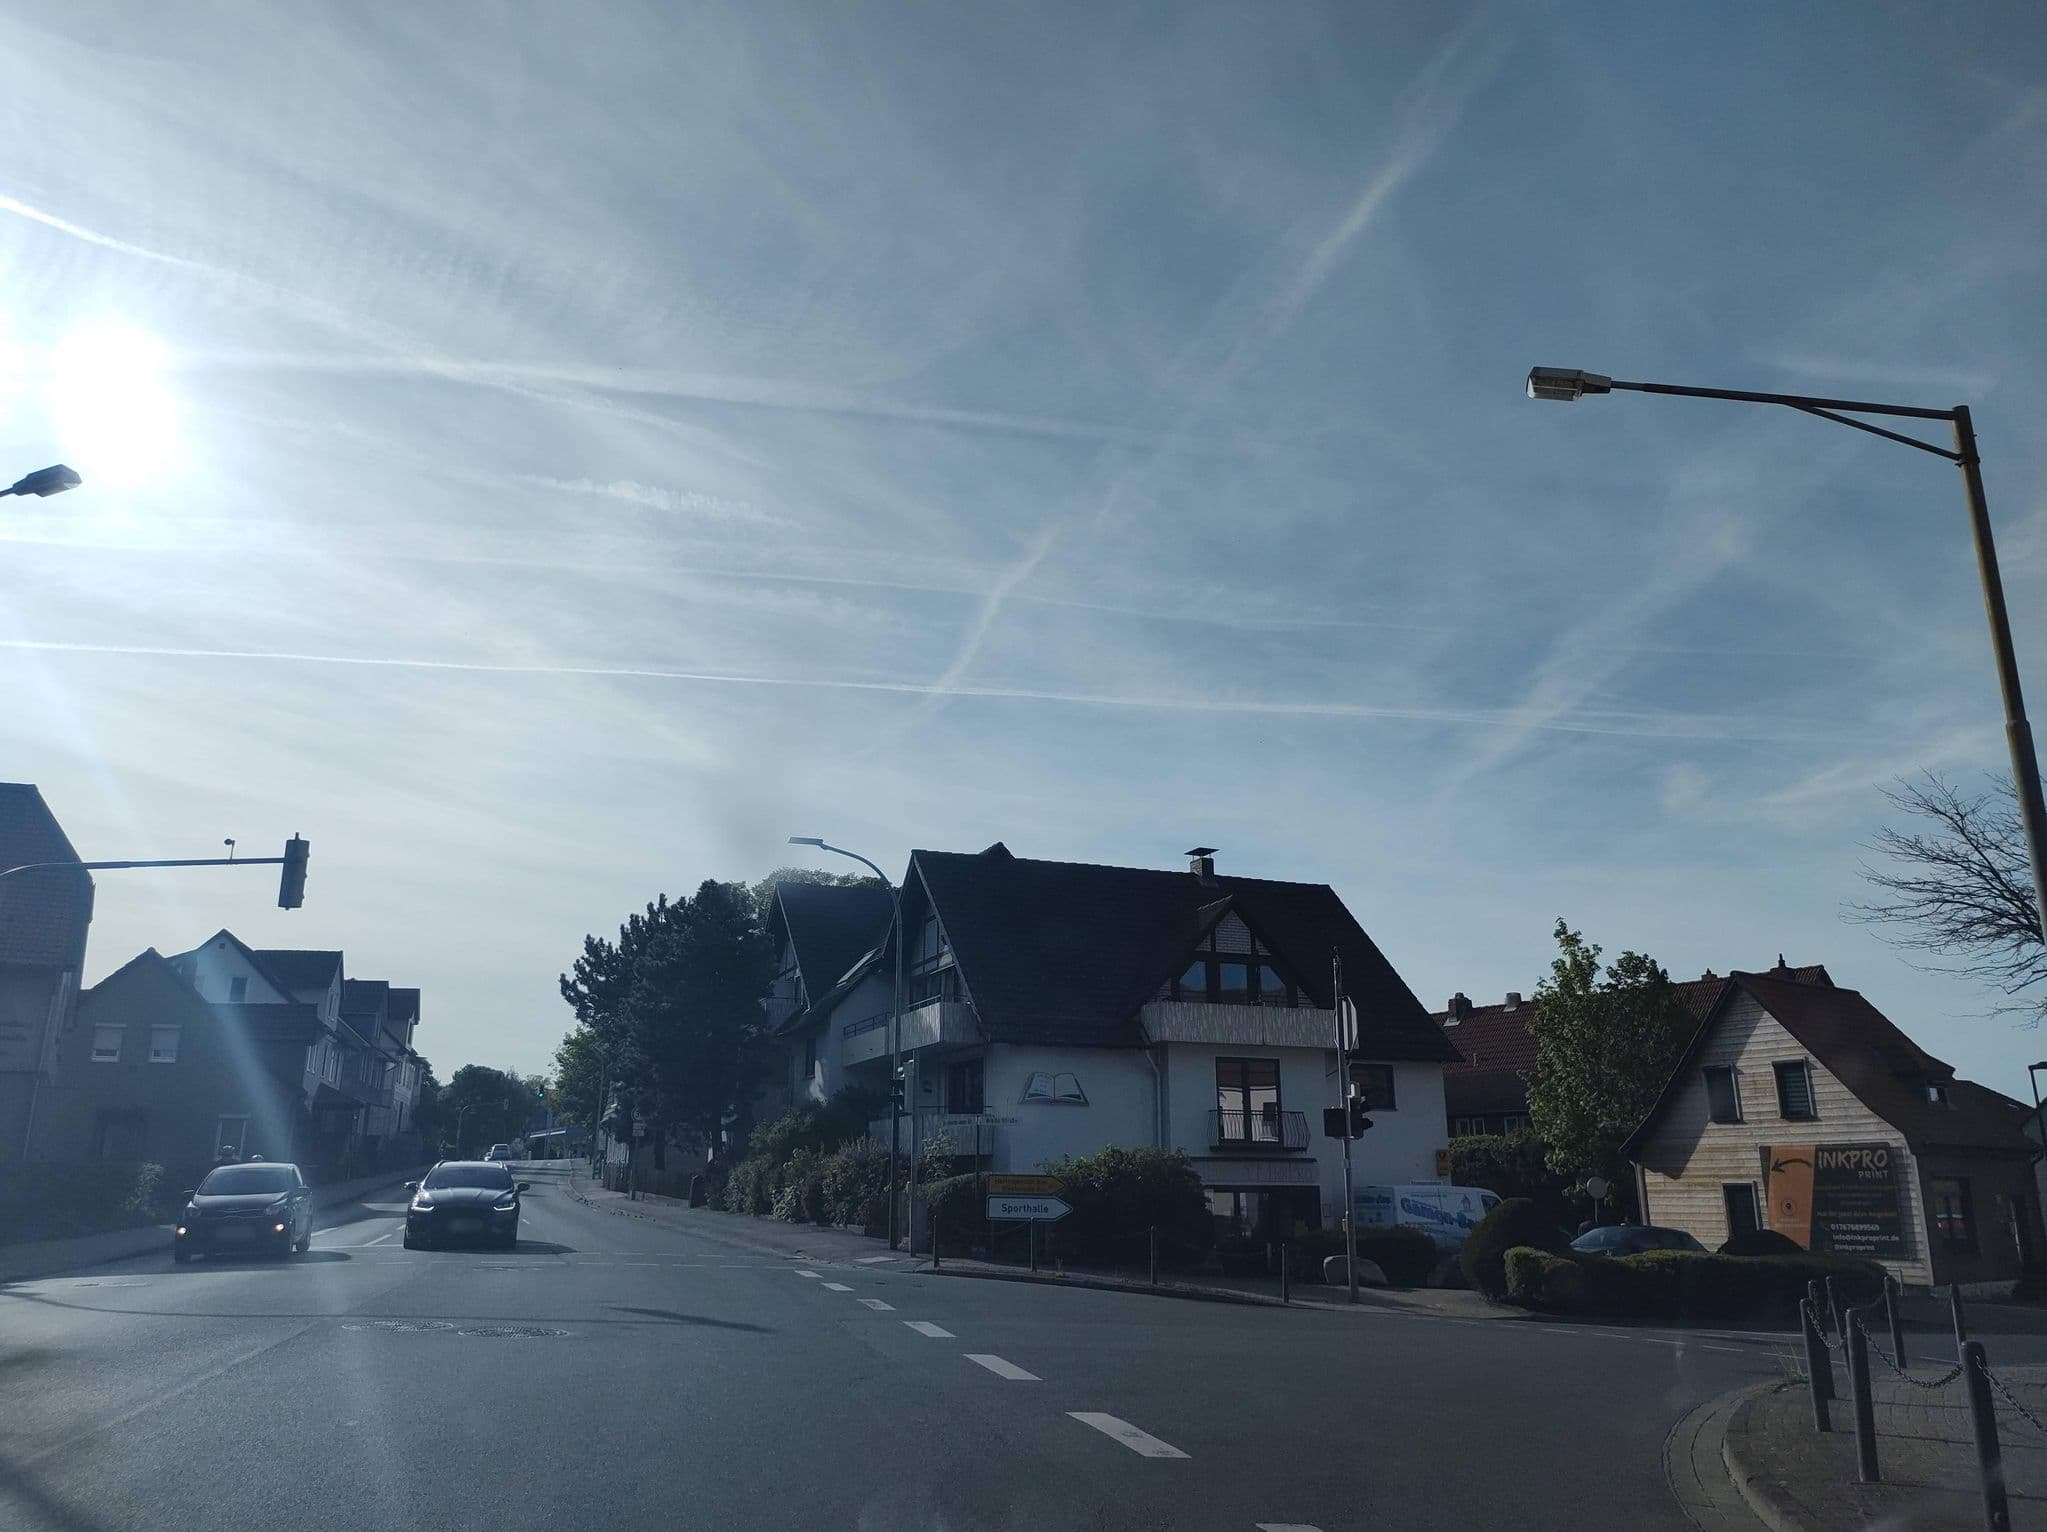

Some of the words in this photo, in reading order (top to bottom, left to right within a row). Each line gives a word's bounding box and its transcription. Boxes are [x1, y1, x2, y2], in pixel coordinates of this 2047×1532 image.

[1818, 1149, 1888, 1170] INKPRO
[1858, 1170, 1888, 1179] PRINT
[1001, 1203, 1049, 1215] Sporthalle
